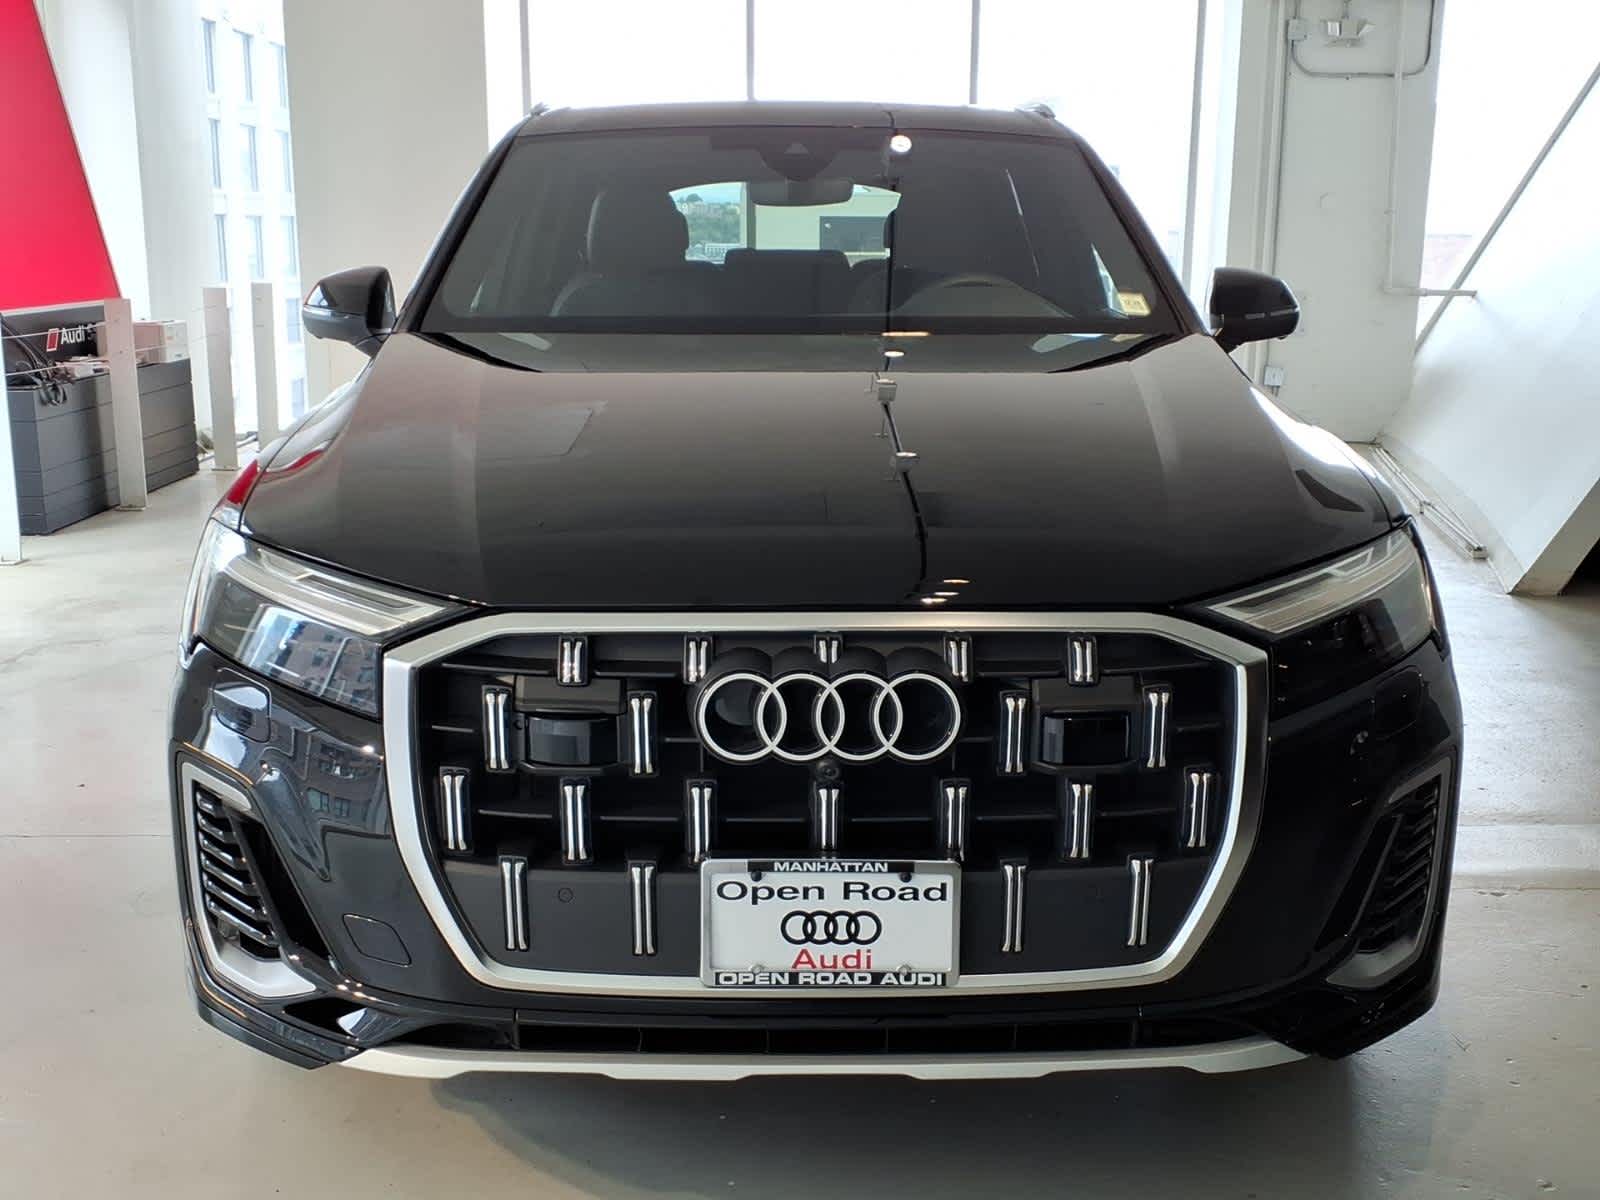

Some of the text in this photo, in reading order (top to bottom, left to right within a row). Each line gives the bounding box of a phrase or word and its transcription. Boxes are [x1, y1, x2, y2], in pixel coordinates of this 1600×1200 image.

[60, 325, 86, 344] Audi
[774, 861, 888, 872] MANHATTAN
[717, 881, 947, 905] Open Road
[791, 949, 872, 969] Audi
[719, 972, 942, 985] OPEN ROAD AUDI
